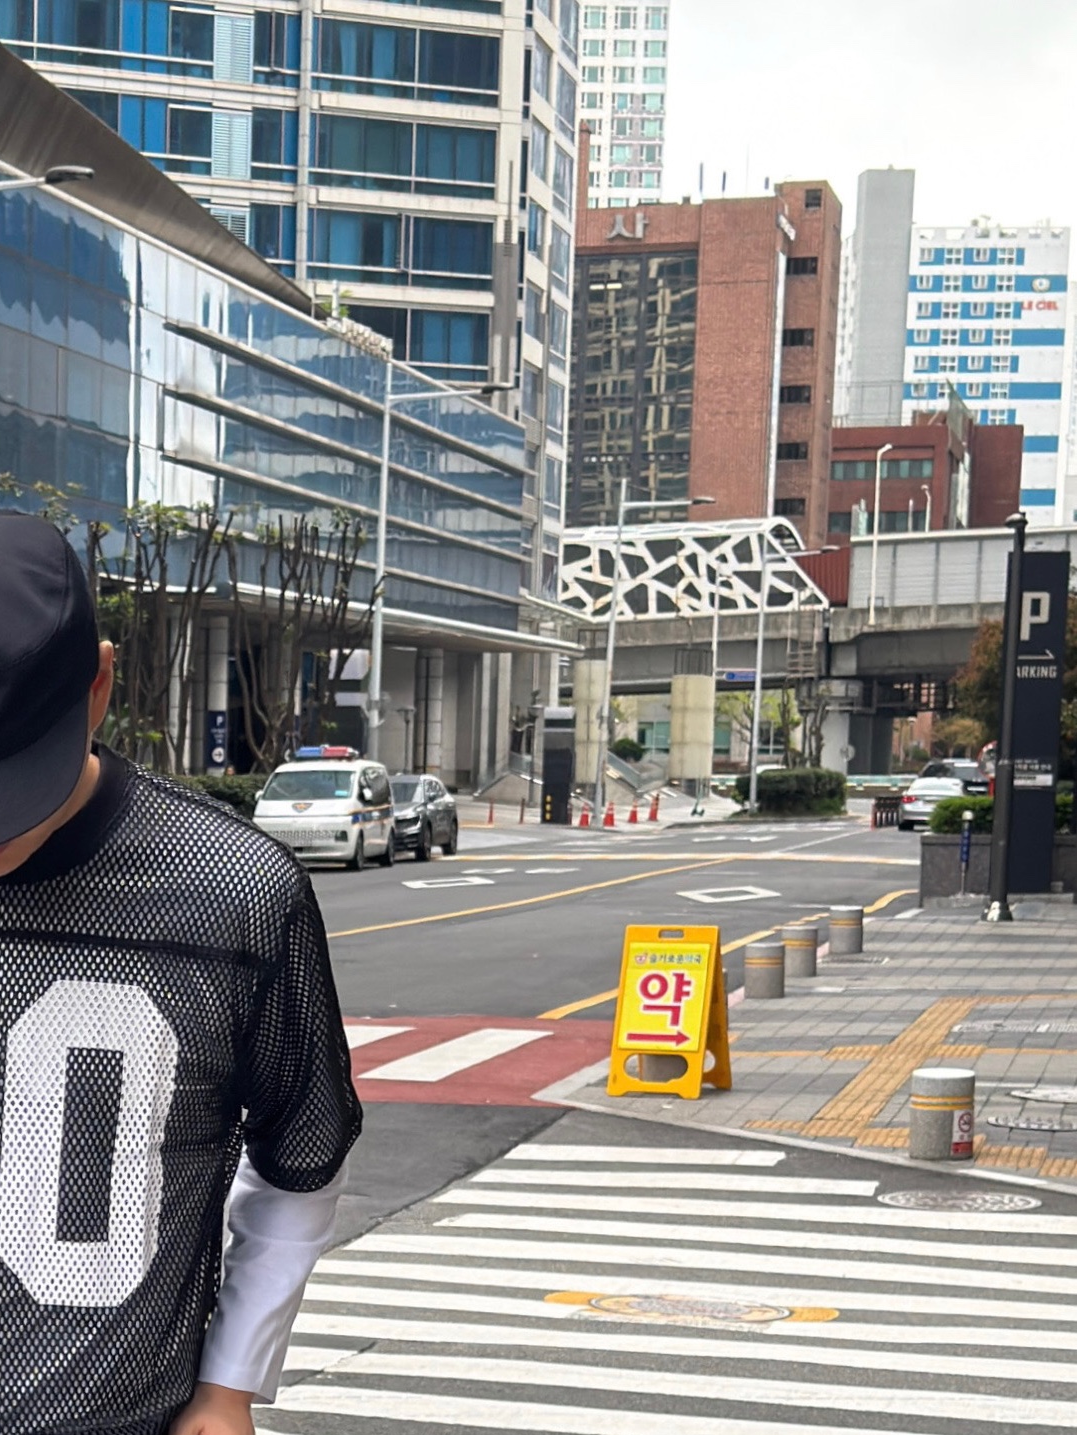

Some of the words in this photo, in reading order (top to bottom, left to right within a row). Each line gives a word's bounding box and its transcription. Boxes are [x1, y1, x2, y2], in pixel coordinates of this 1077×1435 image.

[606, 213, 650, 239] 사
[1020, 591, 1050, 641] P
[640, 973, 691, 1026] 약
